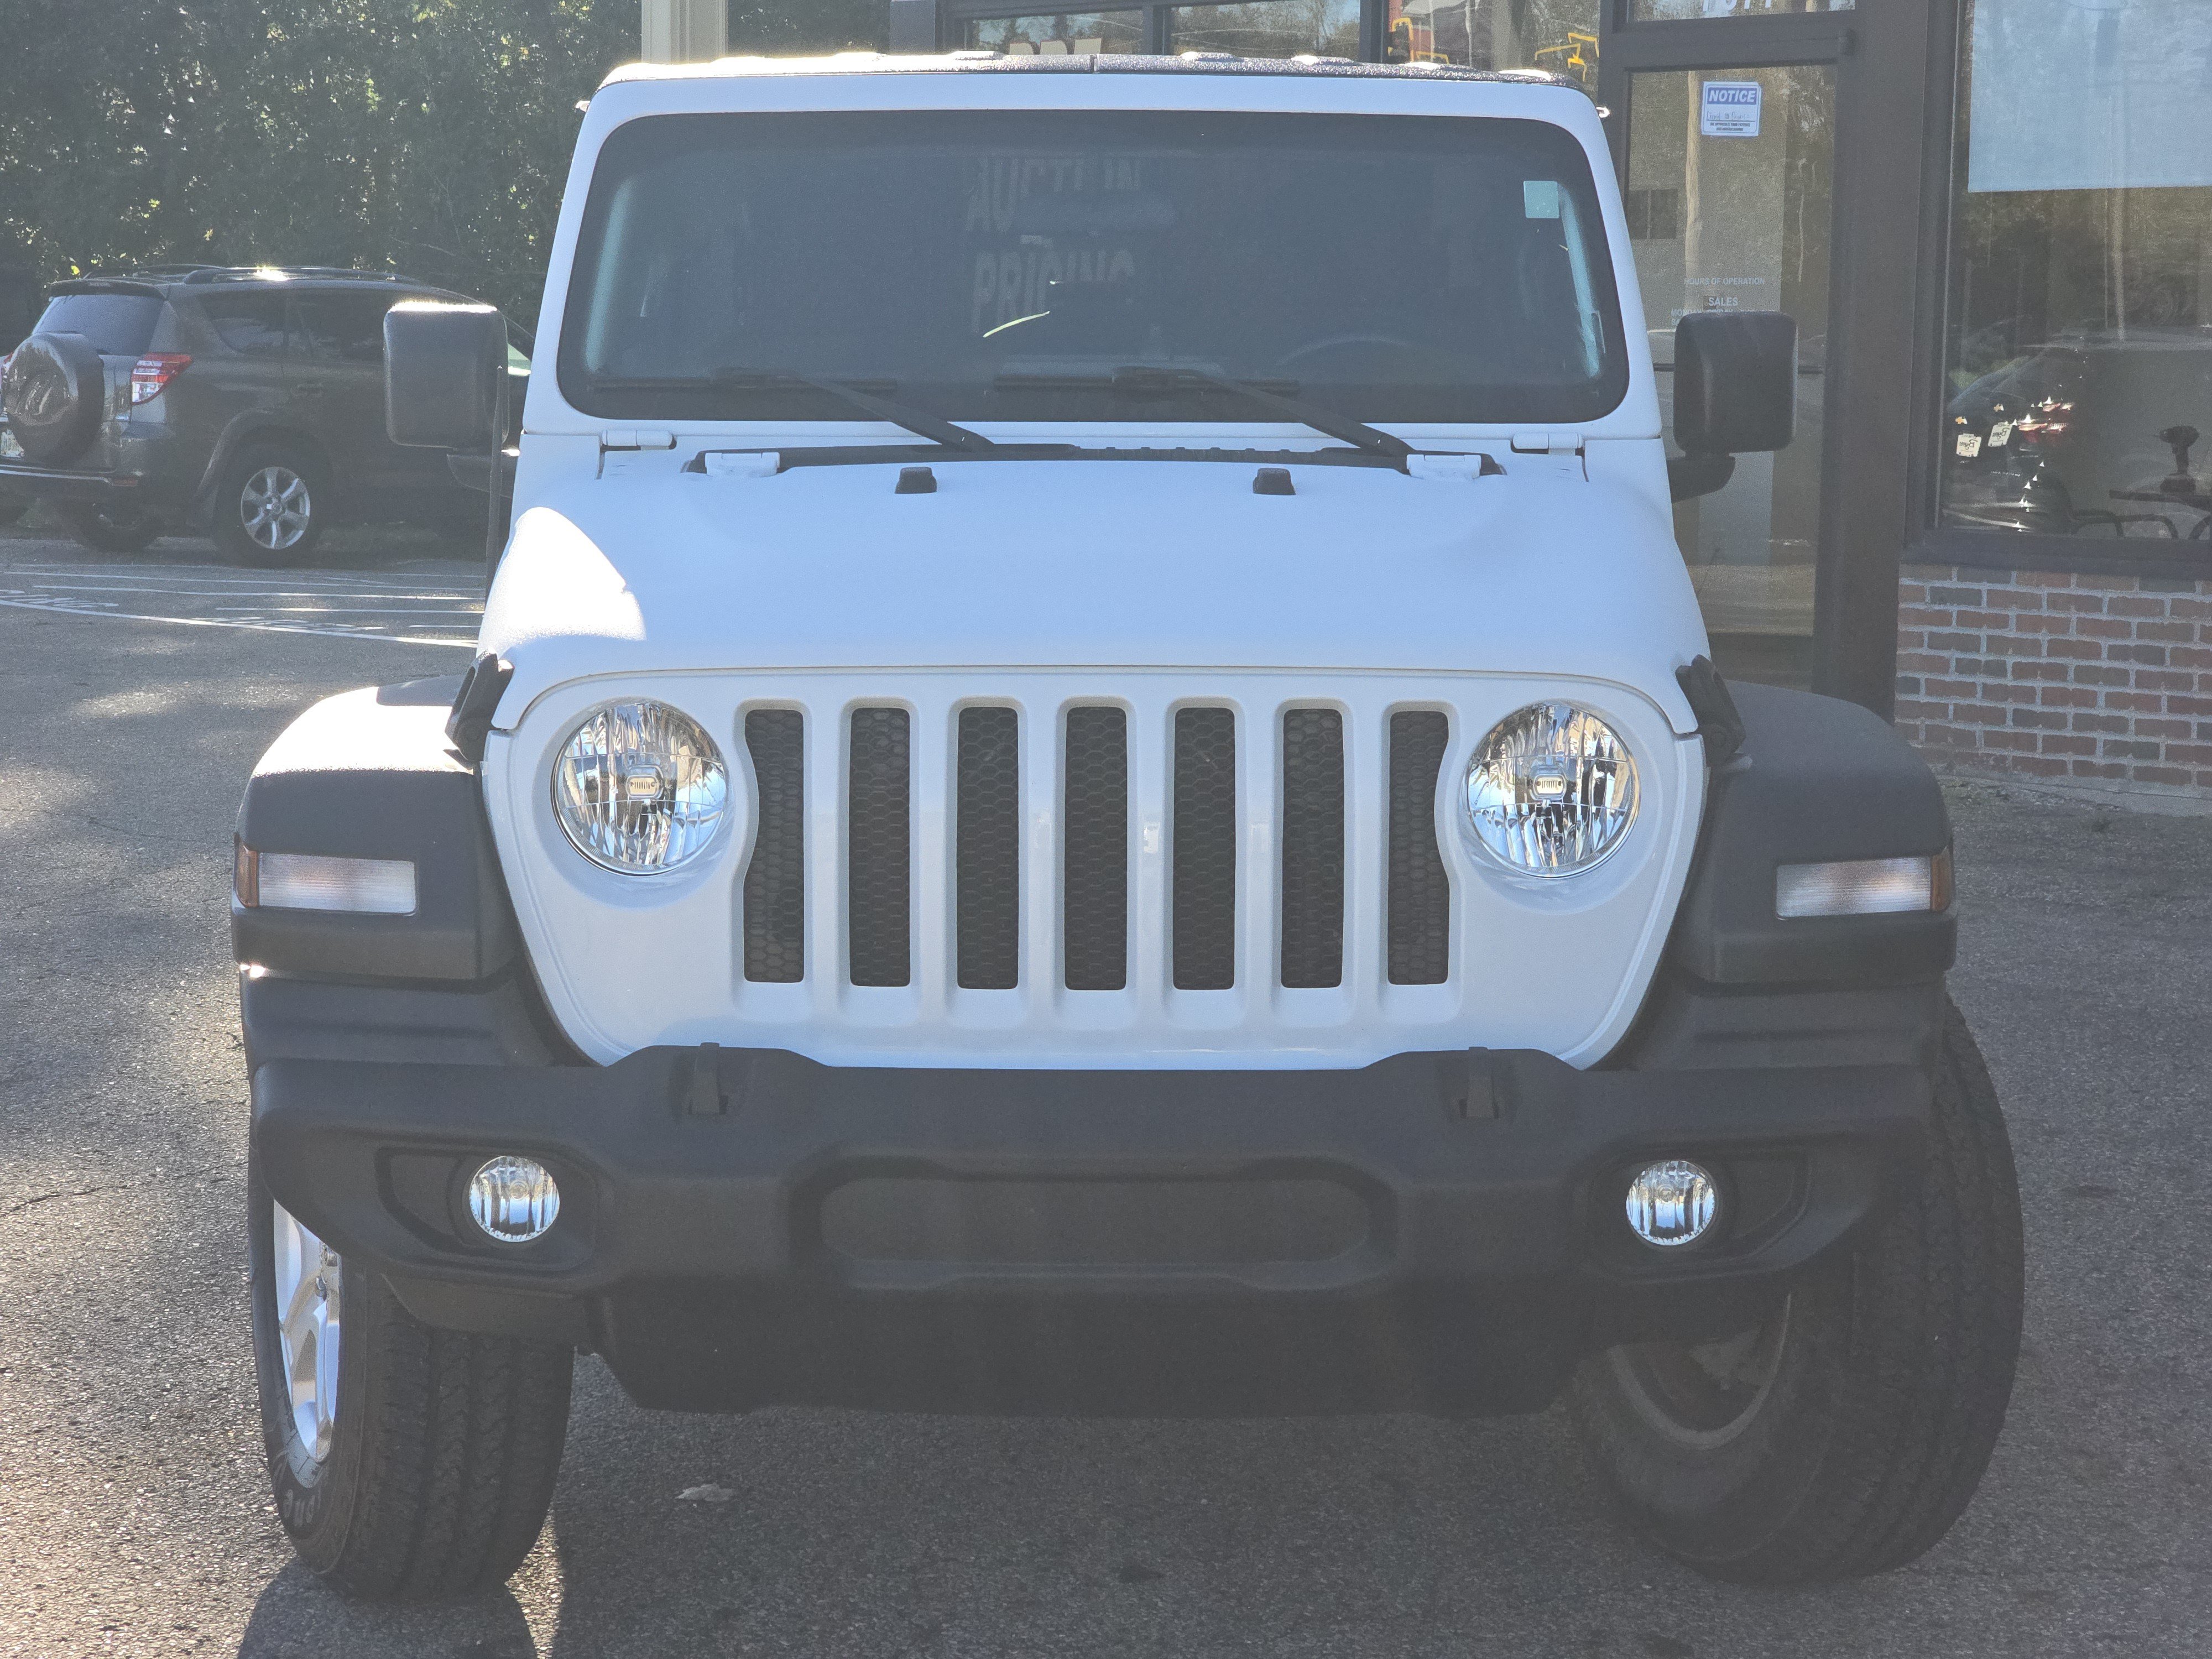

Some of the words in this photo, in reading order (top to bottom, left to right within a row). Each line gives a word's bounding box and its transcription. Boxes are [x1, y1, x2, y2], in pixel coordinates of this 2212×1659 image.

[1709, 90, 1756, 102] NOTICE
[966, 158, 1141, 232] AUCT
[1684, 278, 1710, 286] HOURS
[1723, 277, 1765, 285] OPERATION
[1708, 297, 1739, 306] SALES
